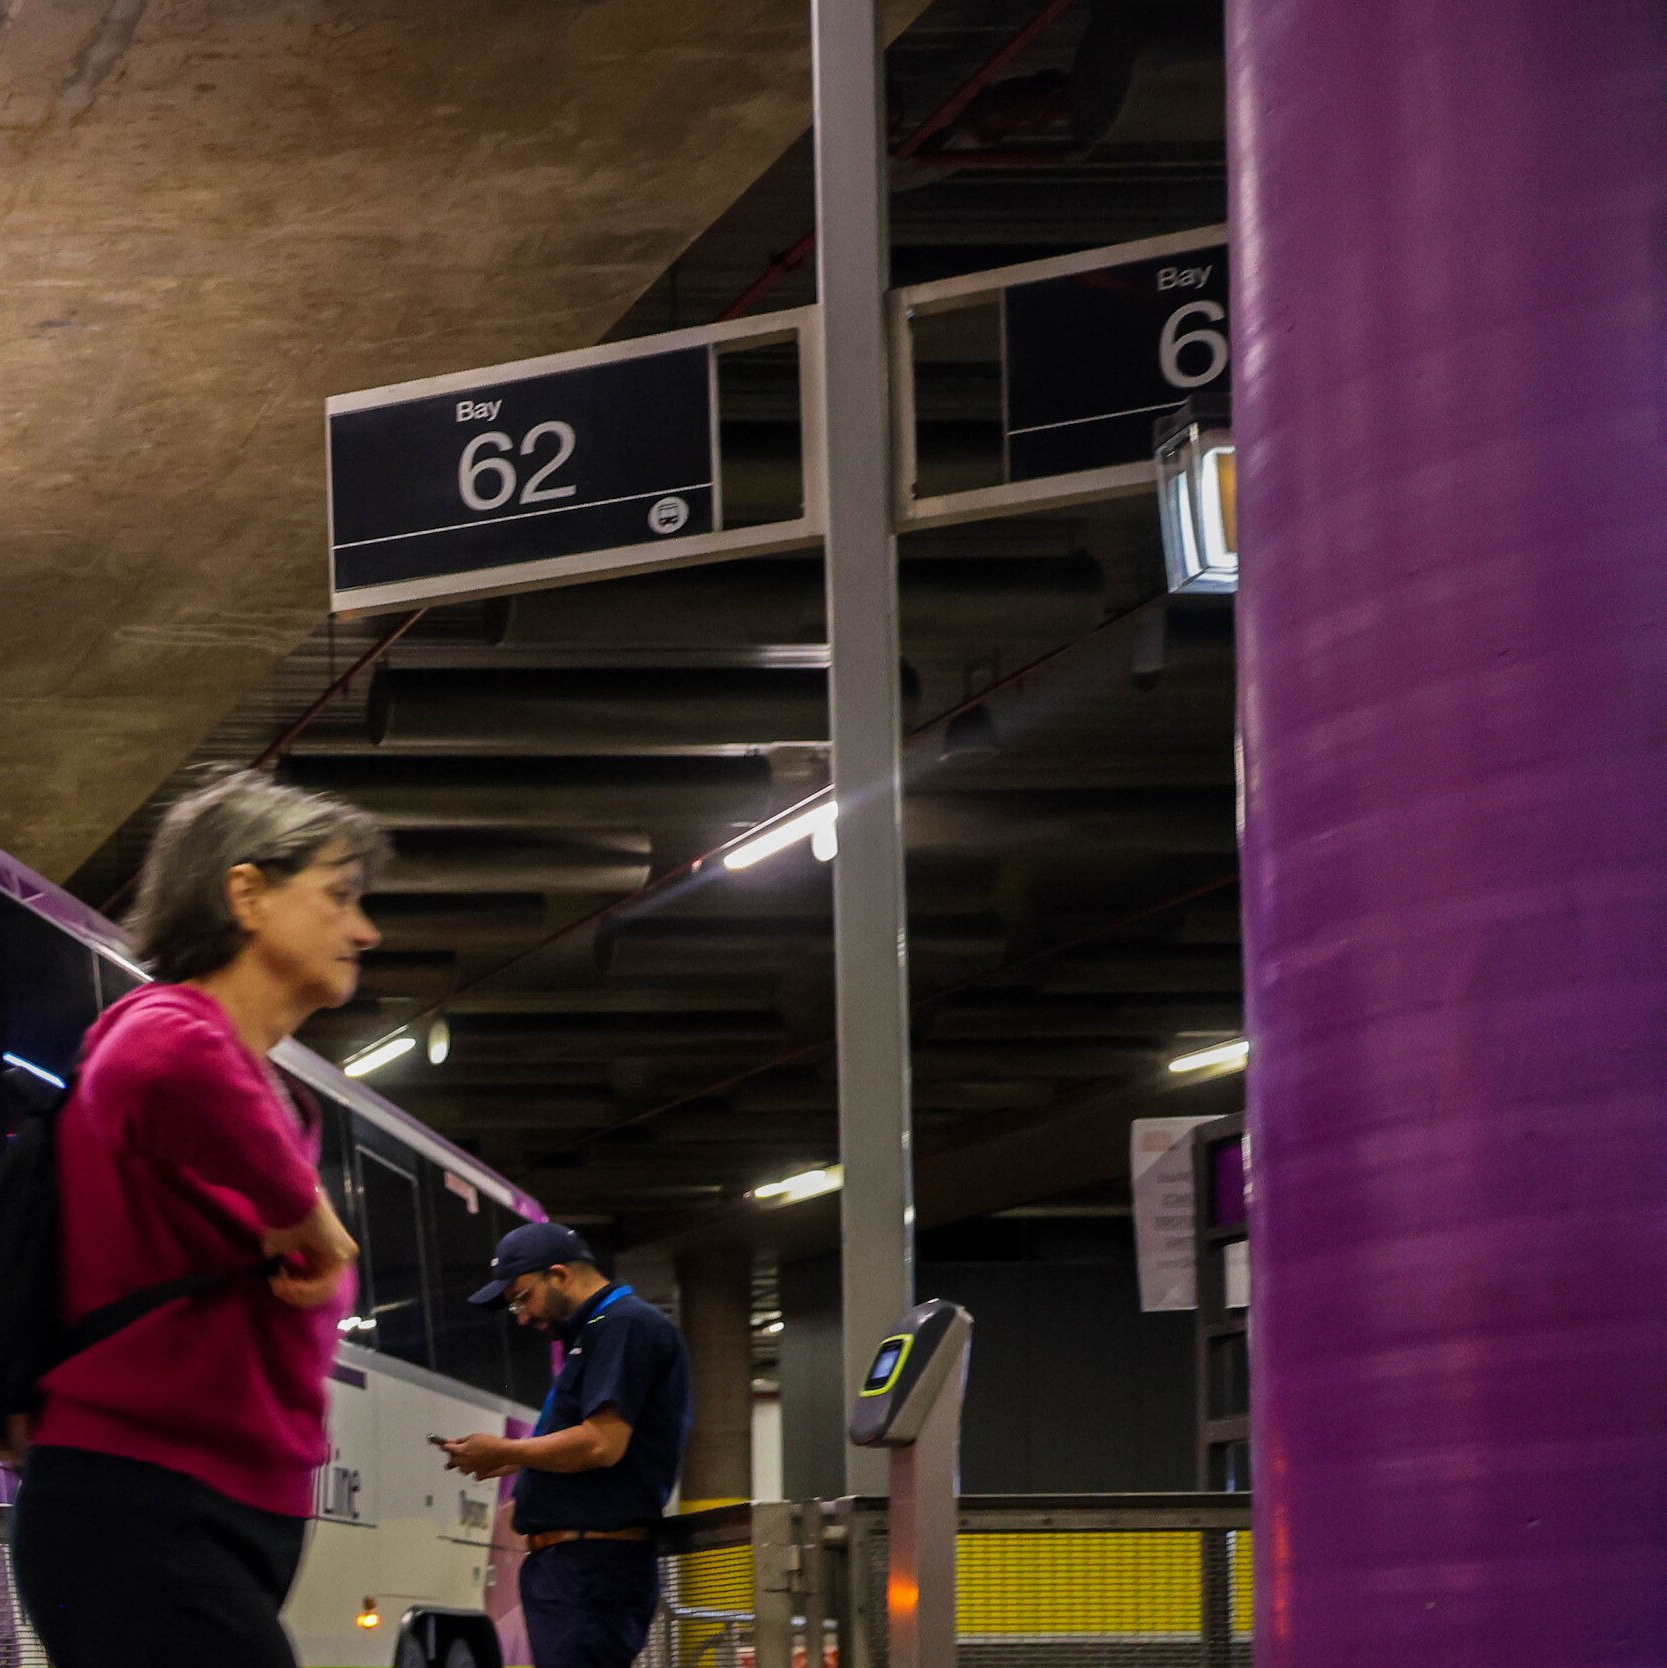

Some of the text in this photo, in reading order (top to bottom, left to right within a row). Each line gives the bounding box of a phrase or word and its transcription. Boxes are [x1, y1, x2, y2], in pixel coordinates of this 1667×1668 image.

[1157, 265, 1212, 290] Bay
[456, 399, 503, 422] Bay
[458, 420, 577, 511] 62
